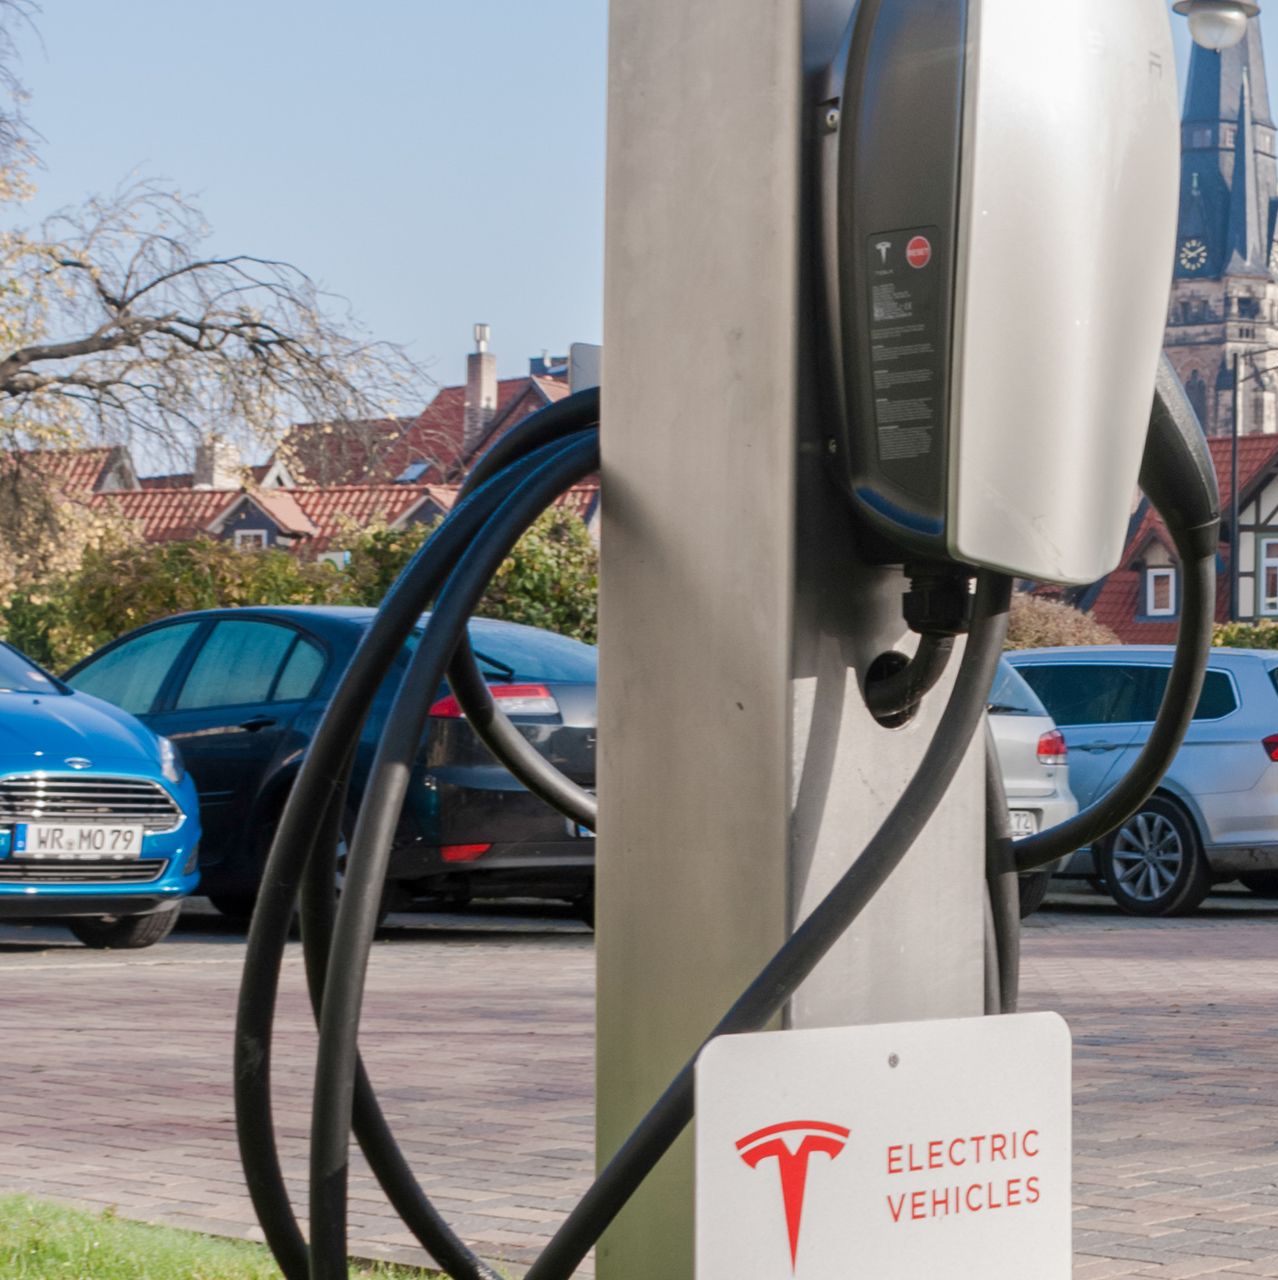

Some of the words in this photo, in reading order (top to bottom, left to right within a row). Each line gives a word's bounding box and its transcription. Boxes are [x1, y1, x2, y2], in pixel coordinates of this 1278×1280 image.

[37, 828, 63, 849] WR
[110, 830, 134, 851] 79
[887, 1130, 1040, 1175] ELECTRIC
[886, 1176, 1041, 1223] VEHICLES
